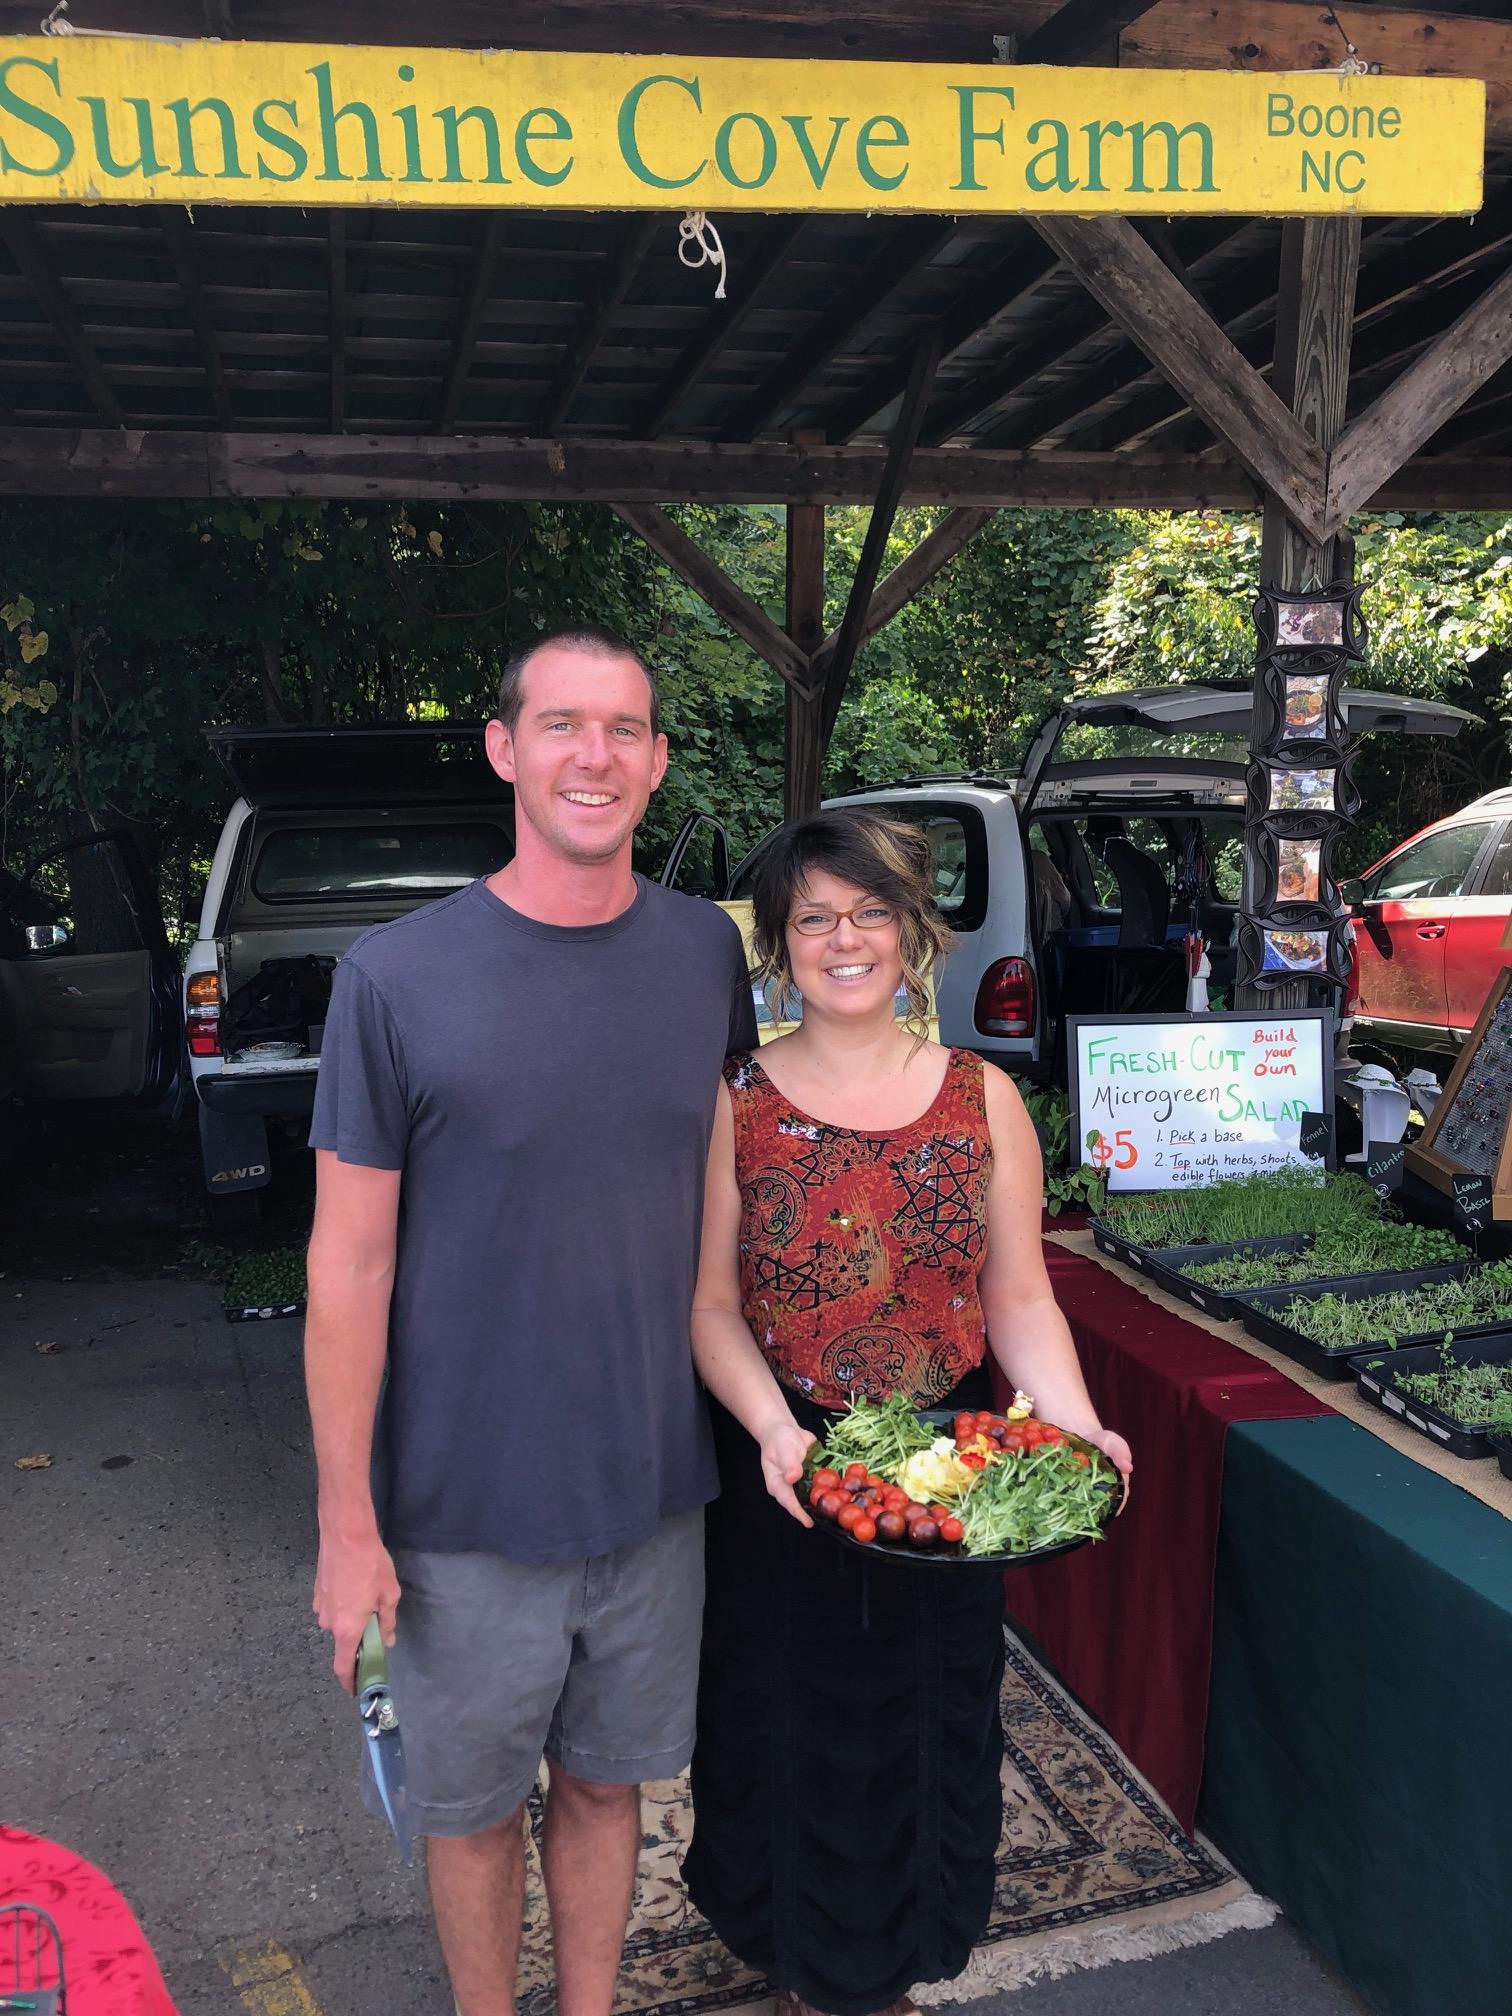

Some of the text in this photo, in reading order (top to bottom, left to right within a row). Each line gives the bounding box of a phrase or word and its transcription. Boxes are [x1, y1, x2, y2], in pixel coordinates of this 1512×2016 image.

[0, 56, 1222, 193] Sunshine Cove Farm
[1267, 93, 1402, 138] Boone
[1301, 150, 1367, 194] NC
[1252, 1028, 1298, 1043] Build
[1265, 1047, 1296, 1063] your
[1091, 1083, 1310, 1122] Microgreen SALAD
[1156, 1129, 1244, 1144] 1. Pick a base
[1301, 1121, 1329, 1147] Fennel
[1093, 1130, 1138, 1169] $5
[1154, 1152, 1167, 1167] 2.
[1169, 1153, 1191, 1170] Top
[1195, 1154, 1218, 1166] with
[211, 1165, 266, 1182] 4WD
[1172, 1170, 1204, 1181] edible
[1368, 1150, 1405, 1178] Cilantro
